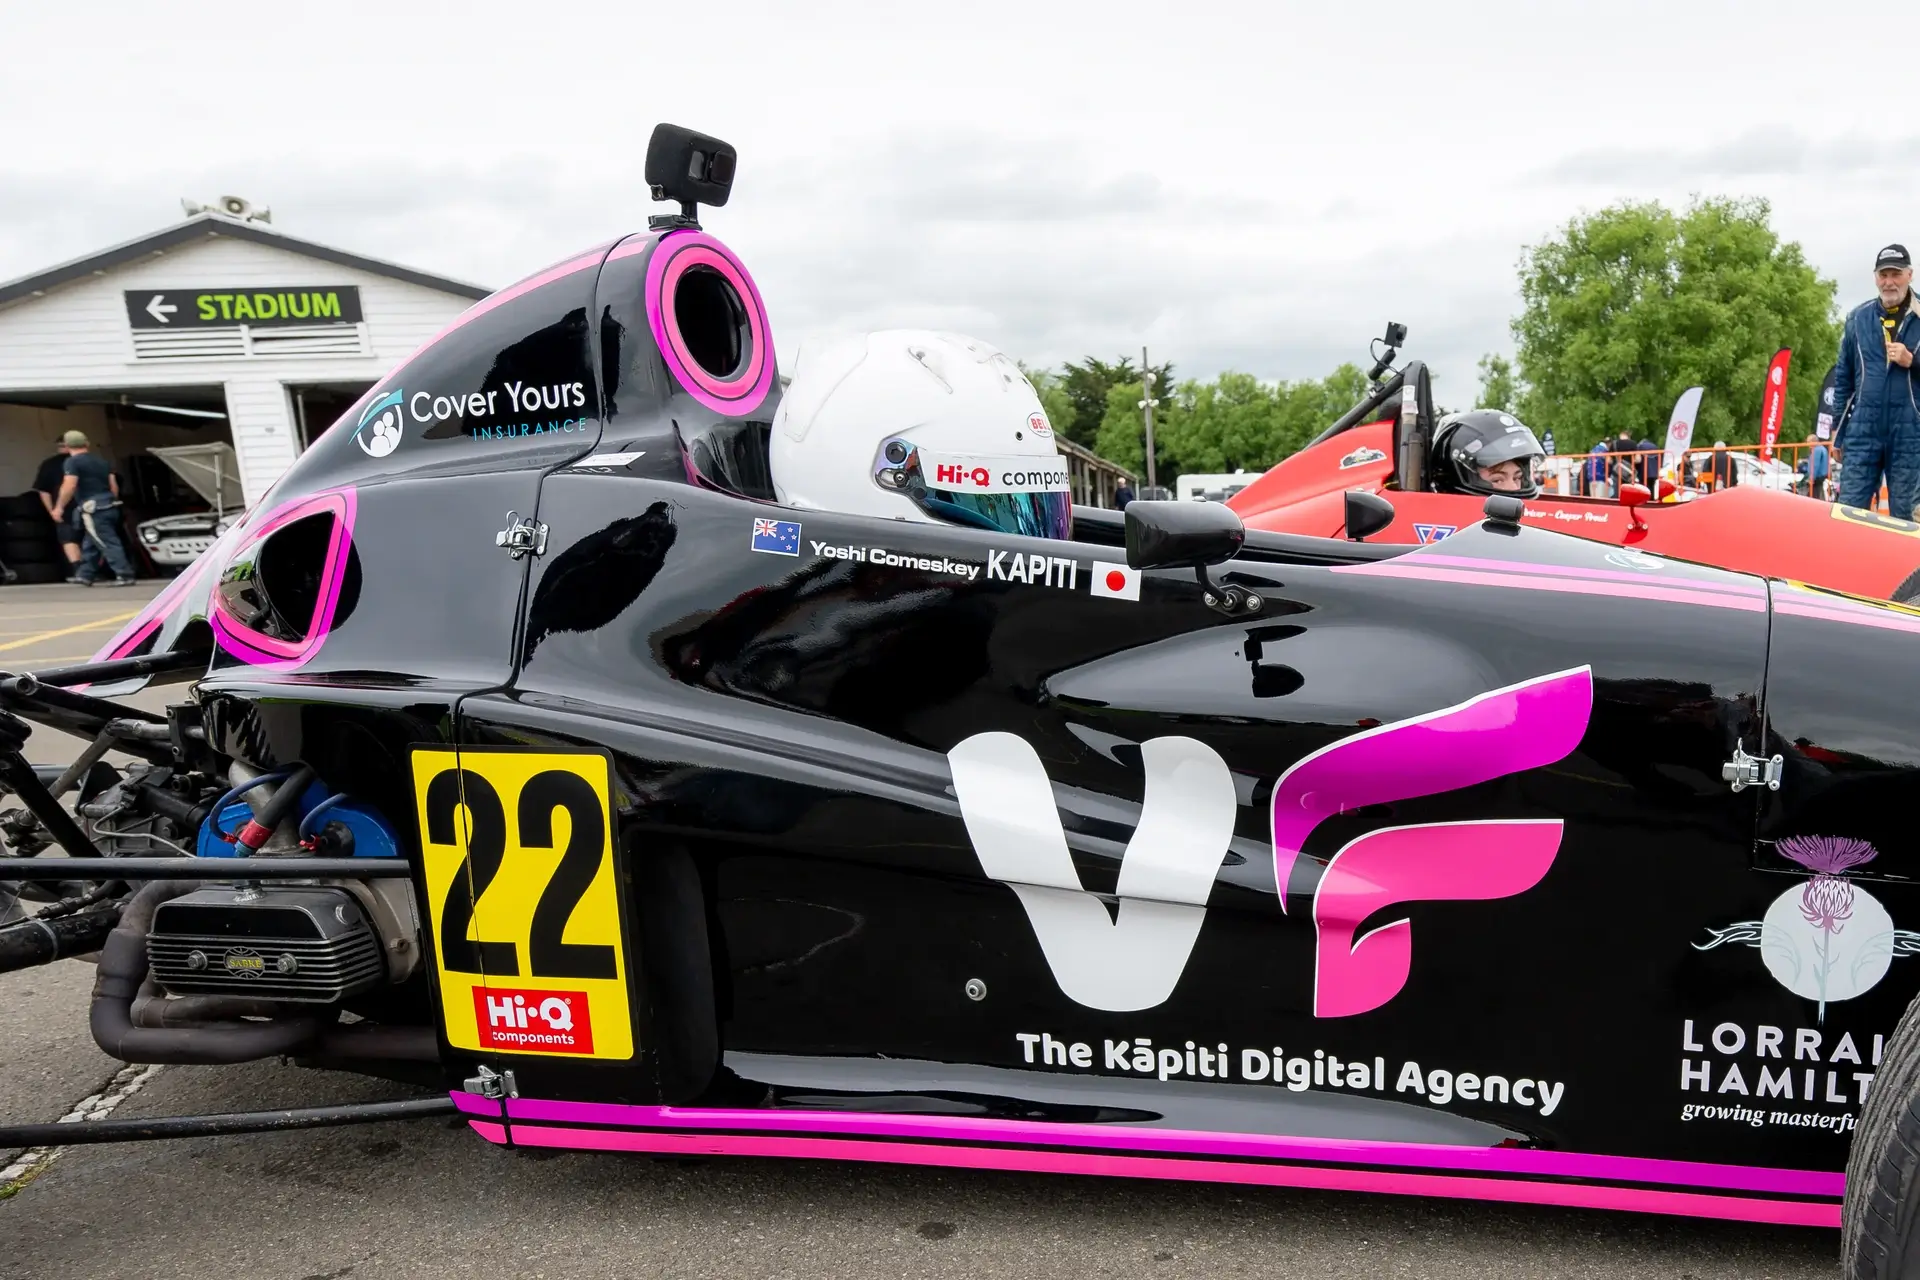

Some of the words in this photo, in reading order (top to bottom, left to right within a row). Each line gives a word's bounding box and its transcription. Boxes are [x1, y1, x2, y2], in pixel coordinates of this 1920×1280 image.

[196, 292, 341, 320] STADIUM
[410, 390, 497, 423] Cover
[504, 380, 586, 413] Yours
[473, 417, 587, 442] INSURANCE
[810, 540, 866, 562] Yoshi
[869, 548, 981, 581] Comeskey
[987, 548, 1078, 590] KAPITI
[426, 768, 618, 981] 22
[229, 959, 262, 969] SABRE
[492, 1031, 575, 1046] components
[1683, 1019, 1884, 1066] LORRAI
[1016, 1032, 1093, 1068] The
[1104, 1037, 1229, 1082] Kāpiti
[1241, 1046, 1385, 1092] Digital
[1396, 1060, 1565, 1117] Agency
[1680, 1102, 1766, 1128] growing
